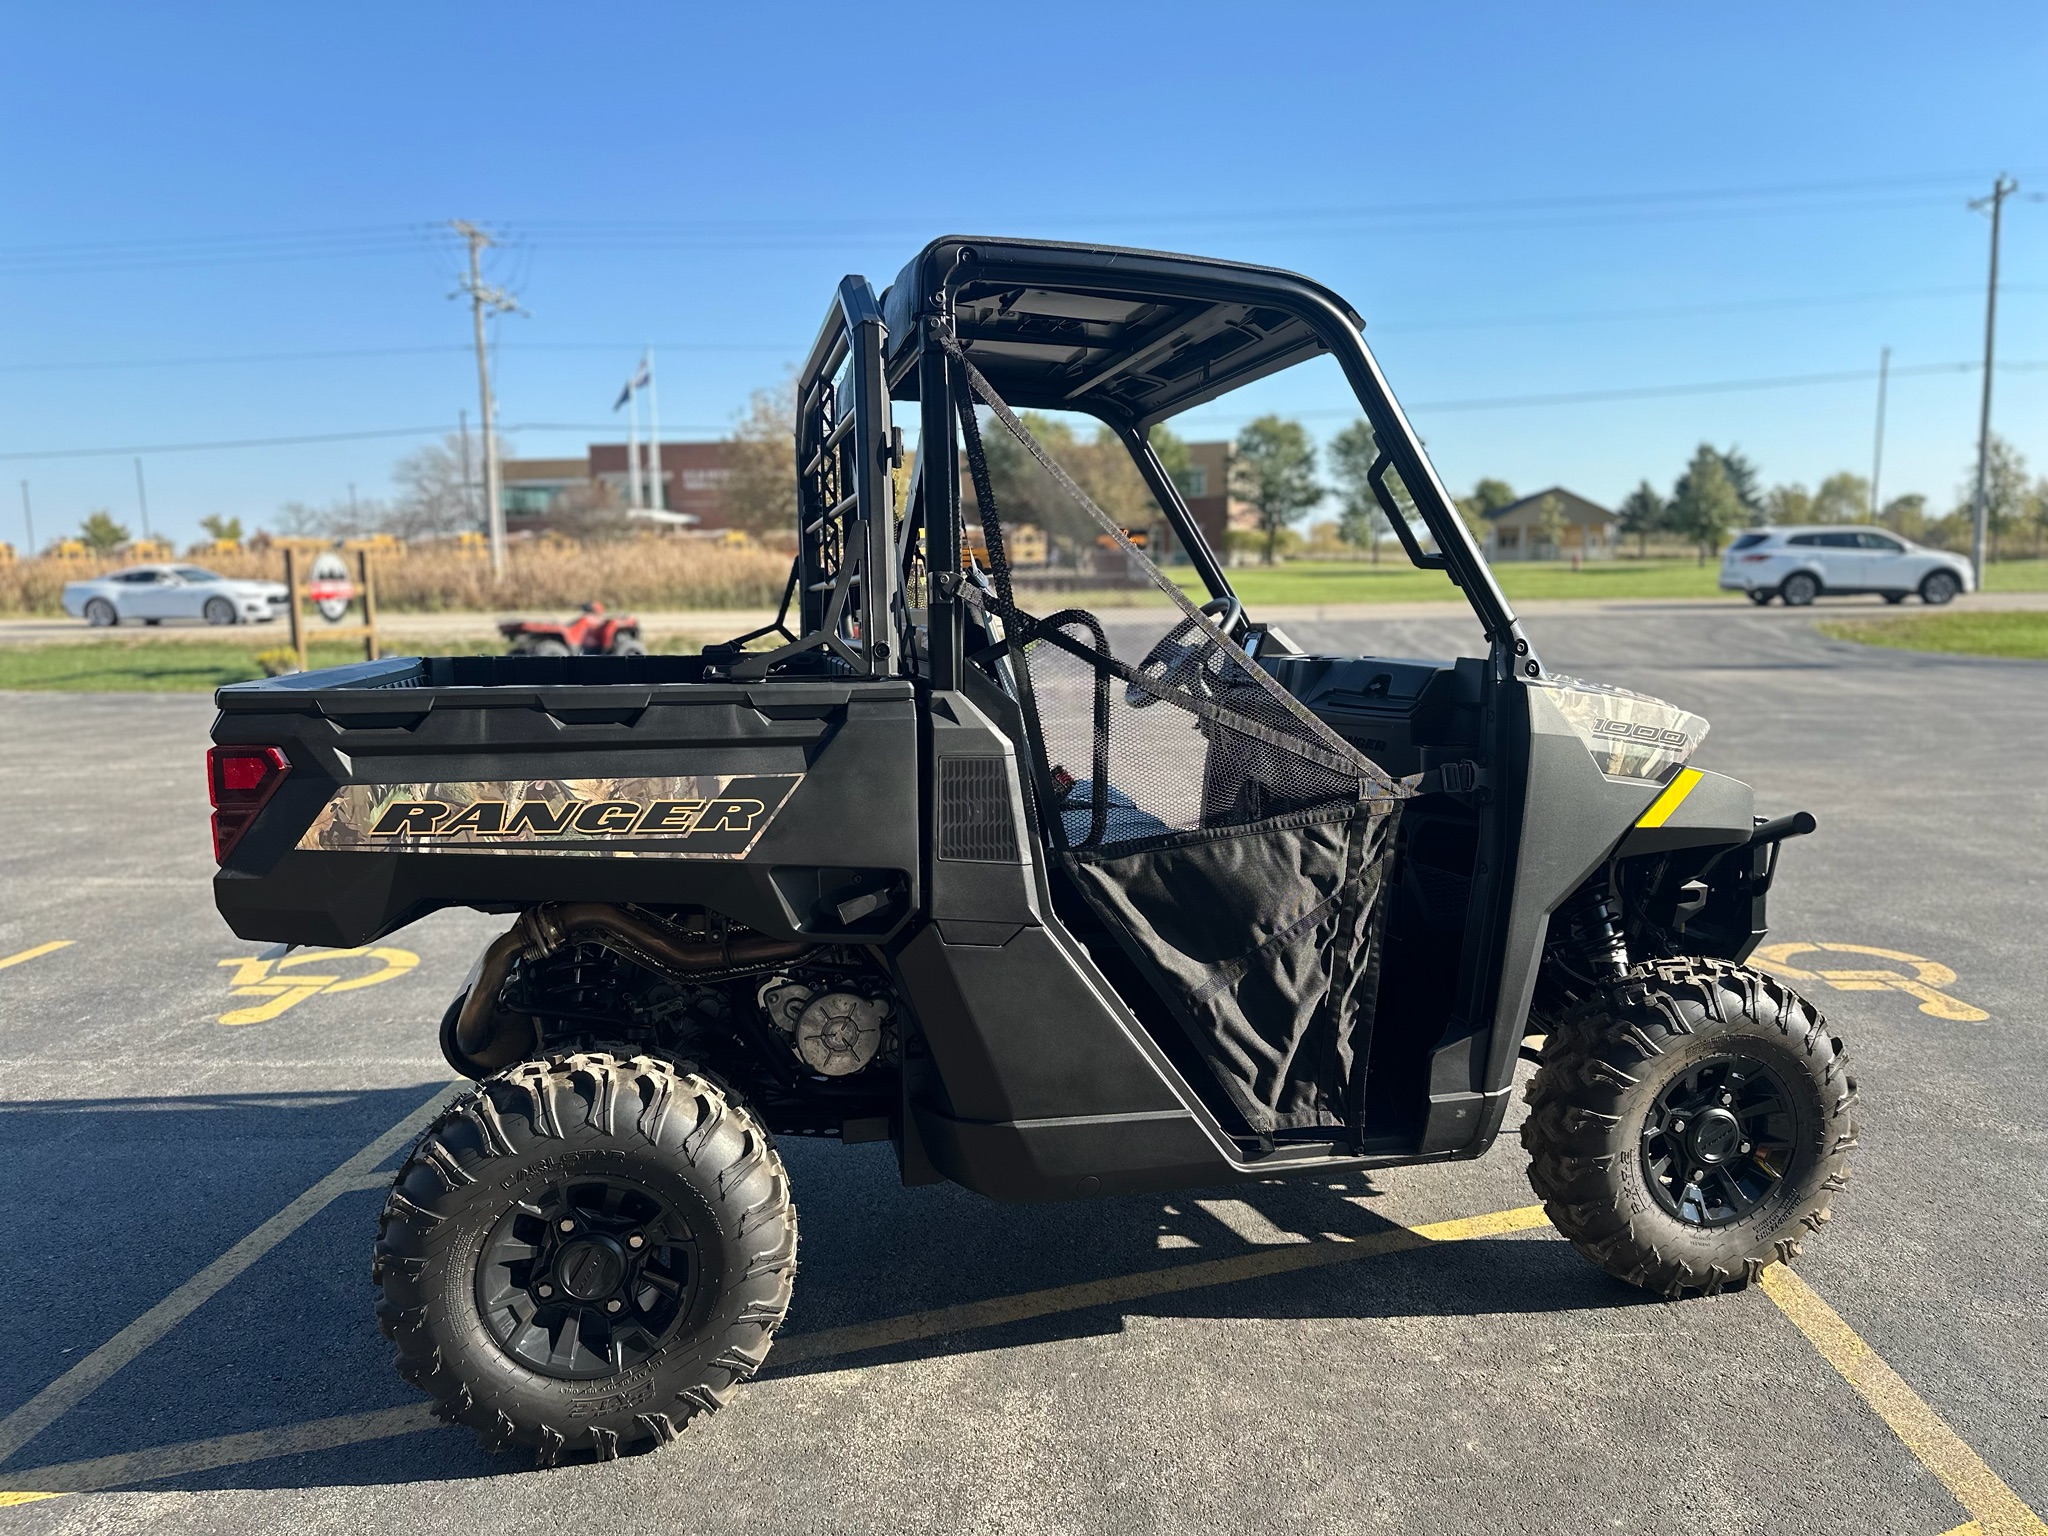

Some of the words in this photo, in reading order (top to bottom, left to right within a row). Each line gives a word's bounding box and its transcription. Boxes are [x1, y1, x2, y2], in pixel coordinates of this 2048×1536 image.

[1592, 717, 1688, 747] 1000
[368, 797, 765, 837] RANGER
[500, 1149, 626, 1191] CARLSTAR
